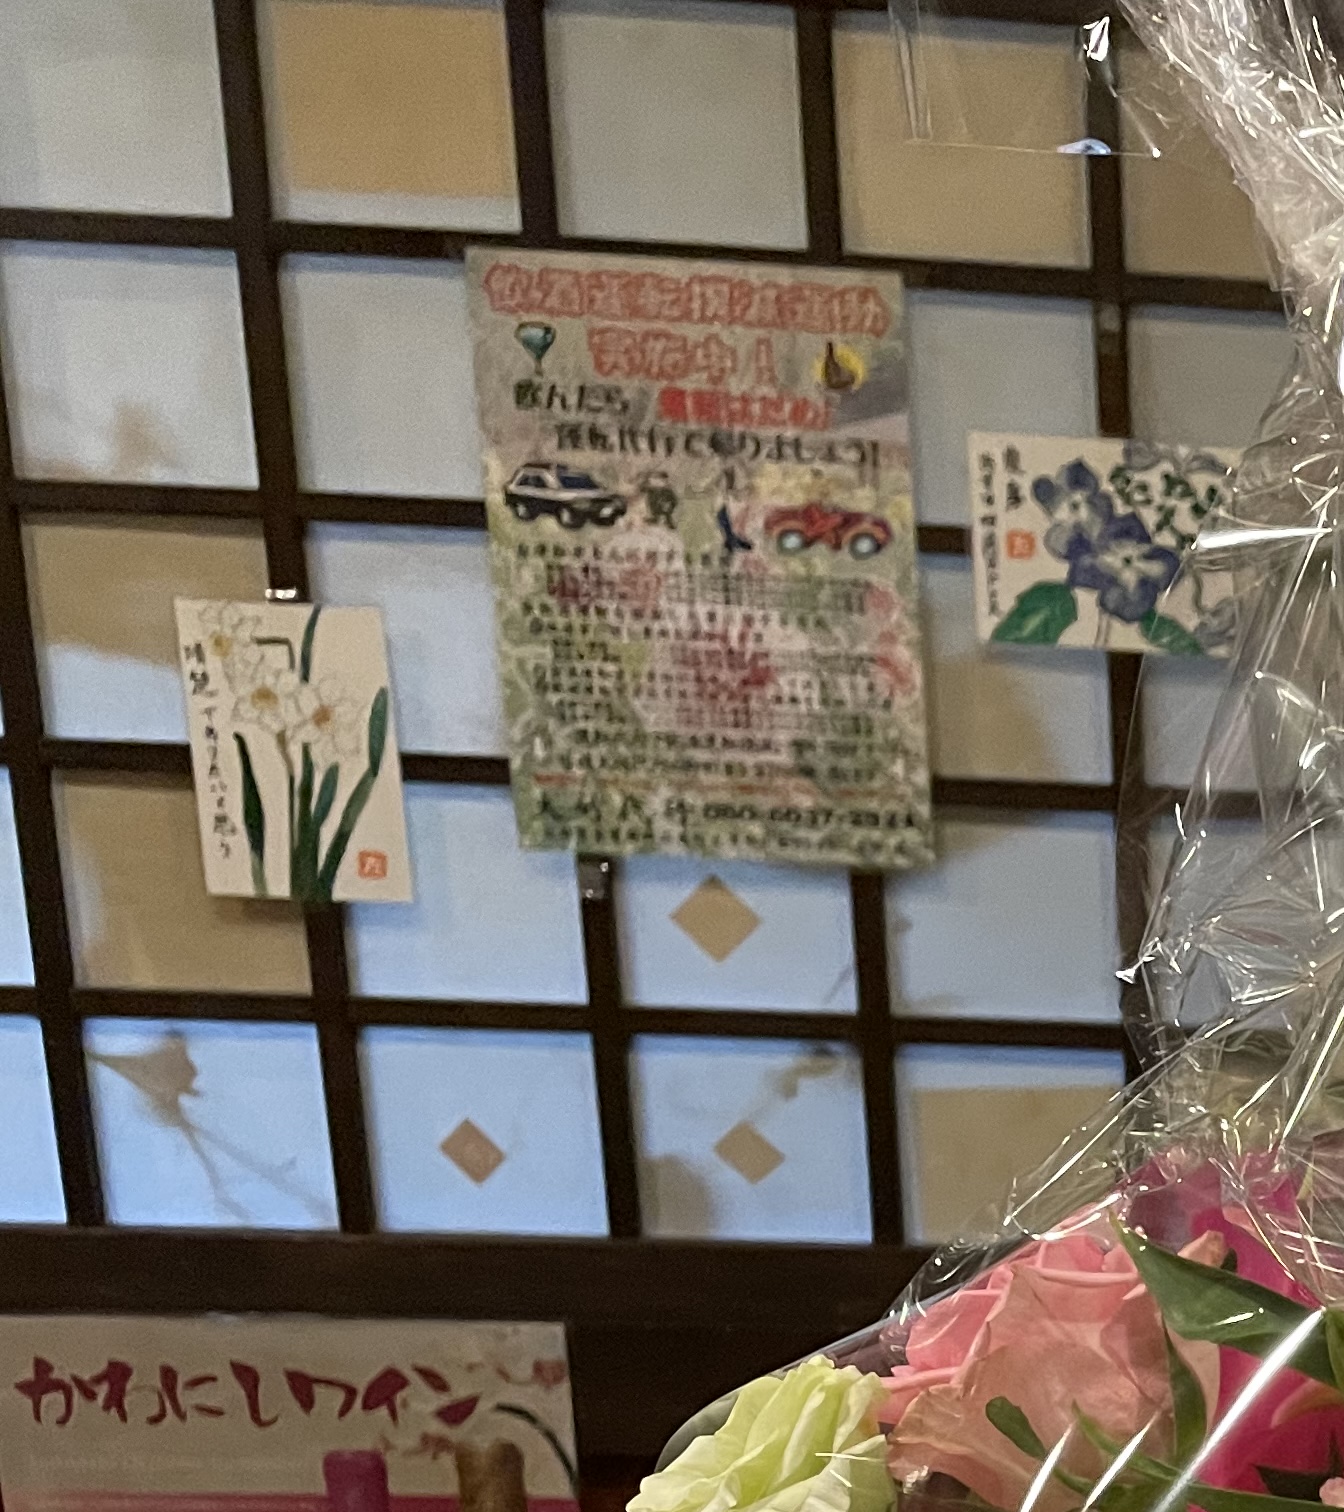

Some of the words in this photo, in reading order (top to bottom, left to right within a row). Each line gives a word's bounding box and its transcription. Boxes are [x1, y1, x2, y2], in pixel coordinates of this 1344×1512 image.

[13, 1354, 483, 1430] かわにしワイン
